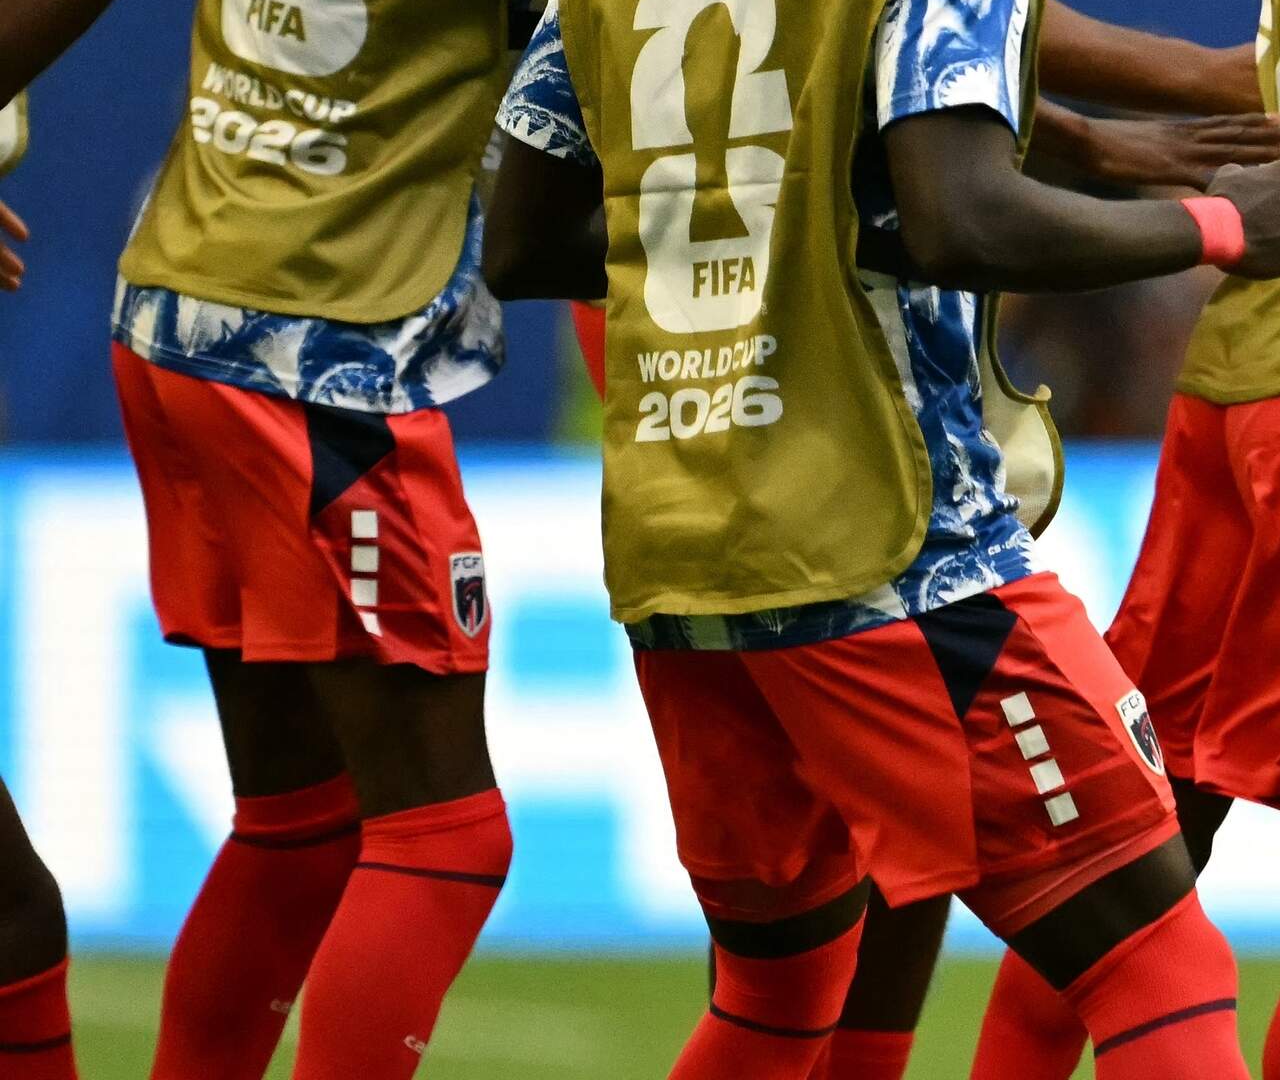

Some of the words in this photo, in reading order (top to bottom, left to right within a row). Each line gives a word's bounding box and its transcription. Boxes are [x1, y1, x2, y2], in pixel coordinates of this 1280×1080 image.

[202, 62, 285, 111] WORLD
[285, 89, 358, 124] CUP
[190, 96, 349, 176] 2026
[691, 255, 756, 299] FIFA
[637, 346, 732, 384] WORLD
[731, 333, 778, 367] CUP
[634, 374, 785, 443] 2026
